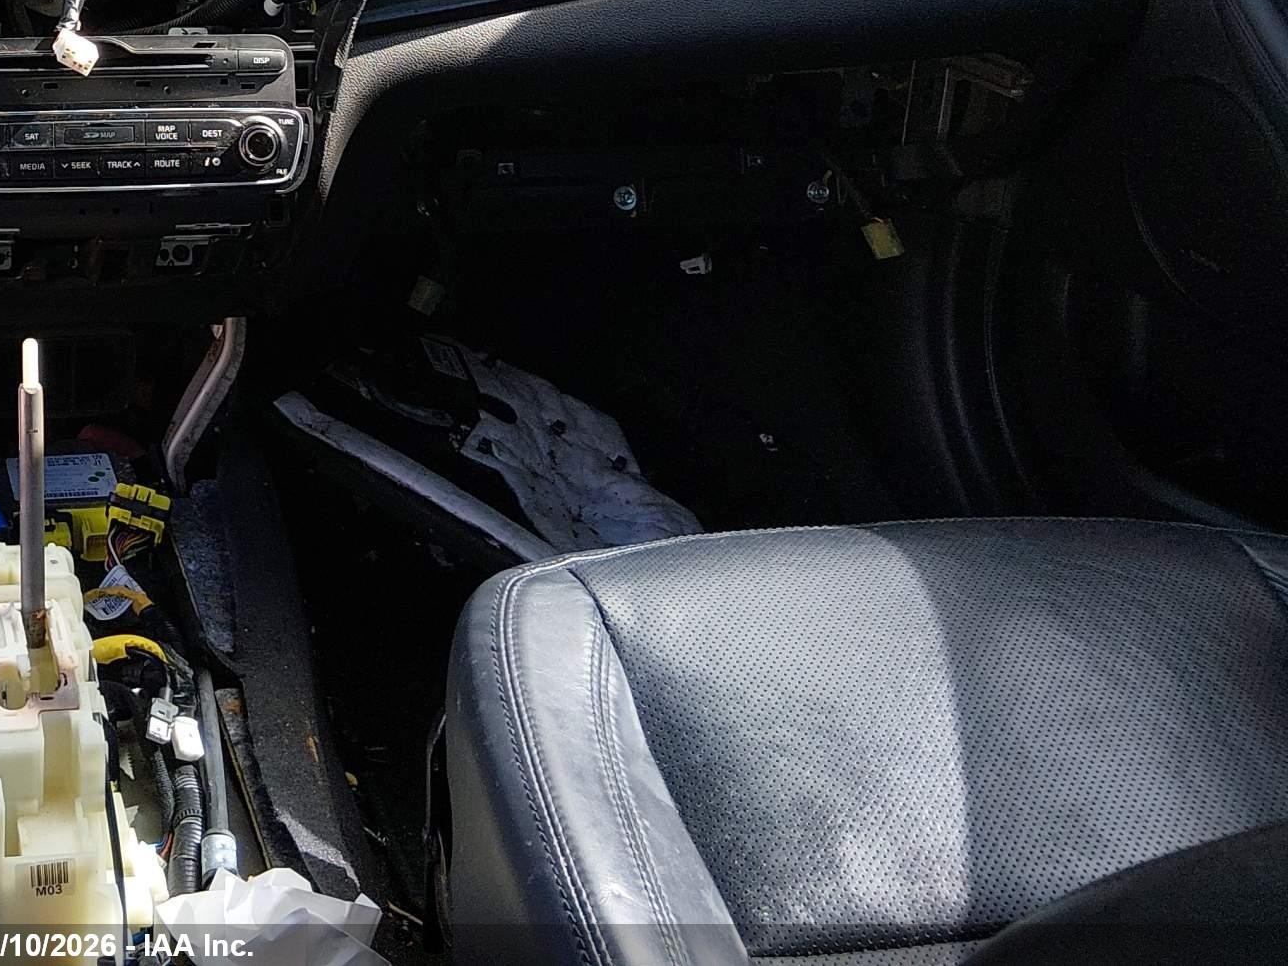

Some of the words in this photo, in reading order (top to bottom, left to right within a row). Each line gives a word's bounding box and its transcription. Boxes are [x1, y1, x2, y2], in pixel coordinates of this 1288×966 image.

[157, 125, 176, 133] MAP
[202, 129, 223, 137] DEST
[24, 133, 40, 141] SAT
[155, 132, 178, 140] VOICE
[19, 163, 46, 171] MEDIA
[71, 161, 92, 170] SEEK
[107, 160, 133, 169] TRACK
[154, 159, 181, 168] ROUTE
[35, 884, 63, 897] M03
